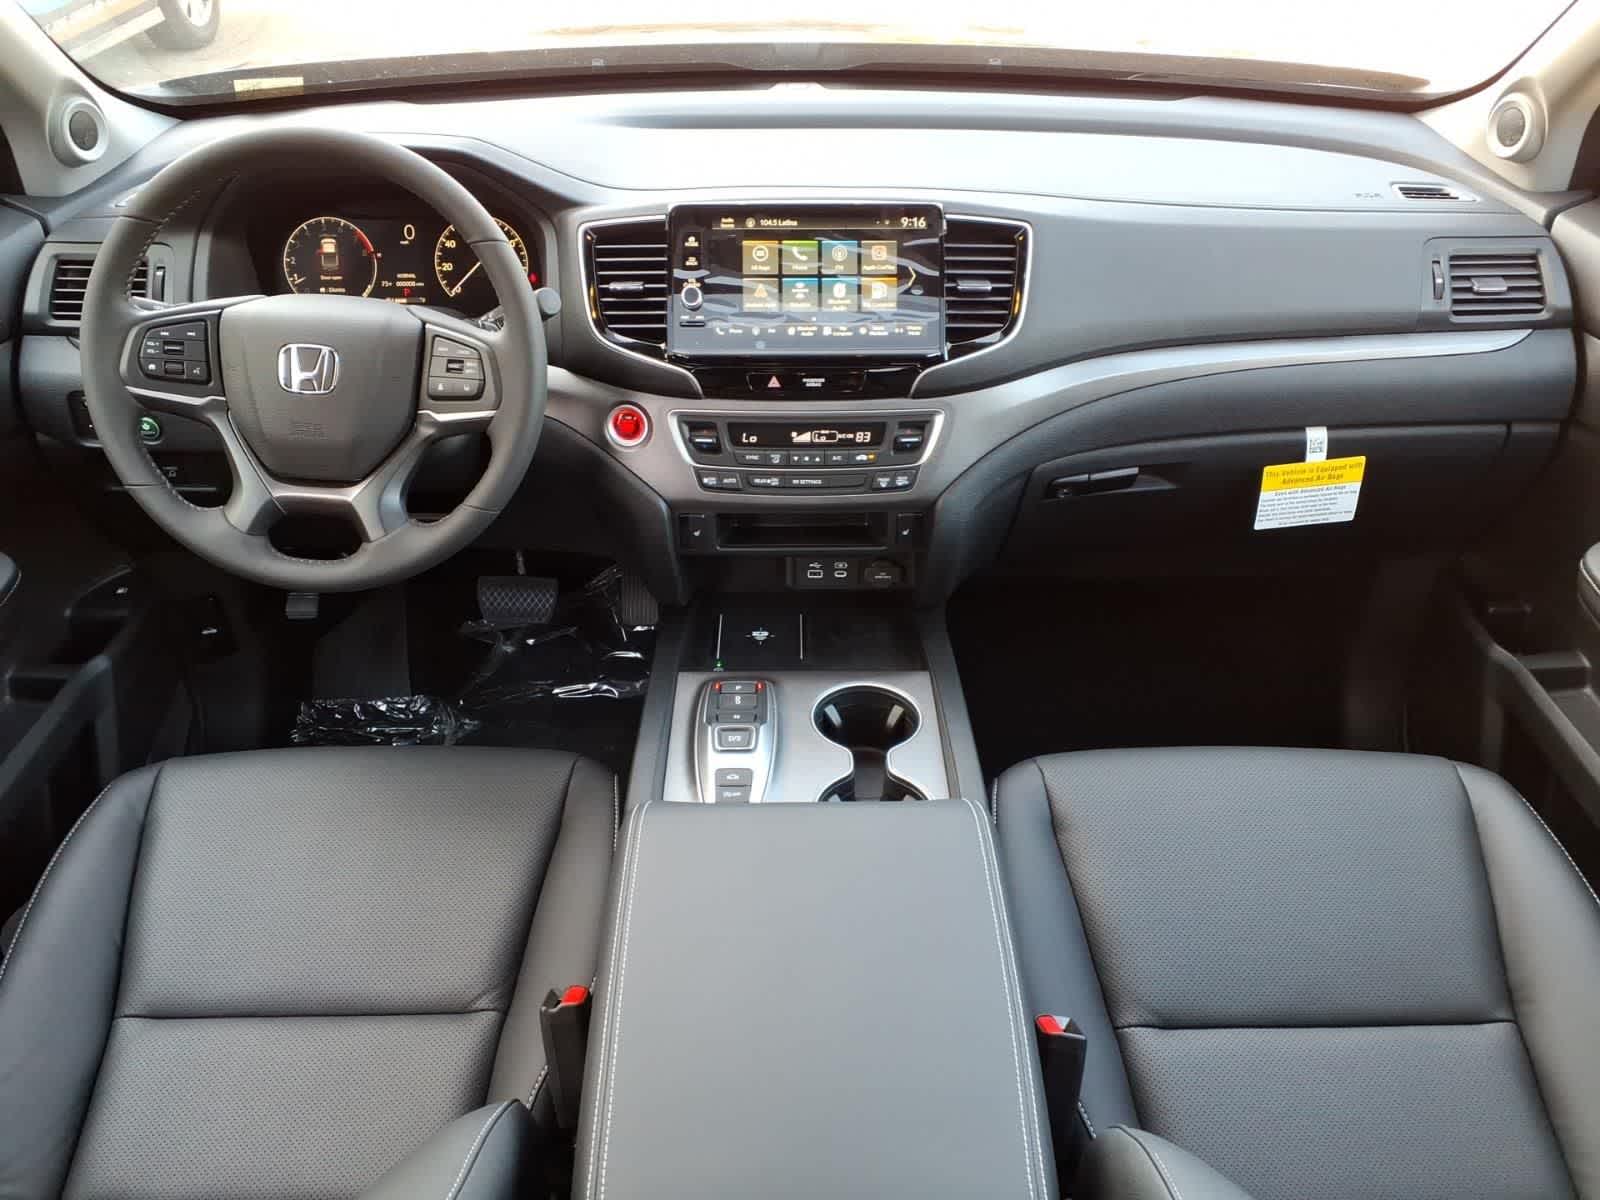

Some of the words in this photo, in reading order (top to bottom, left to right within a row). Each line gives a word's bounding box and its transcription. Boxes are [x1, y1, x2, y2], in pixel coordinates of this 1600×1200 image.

[901, 217, 926, 228] 9:16
[403, 224, 415, 240] 0
[444, 240, 456, 248] 40
[441, 263, 453, 271] 20
[741, 432, 758, 443] Lo
[855, 431, 871, 442] 83
